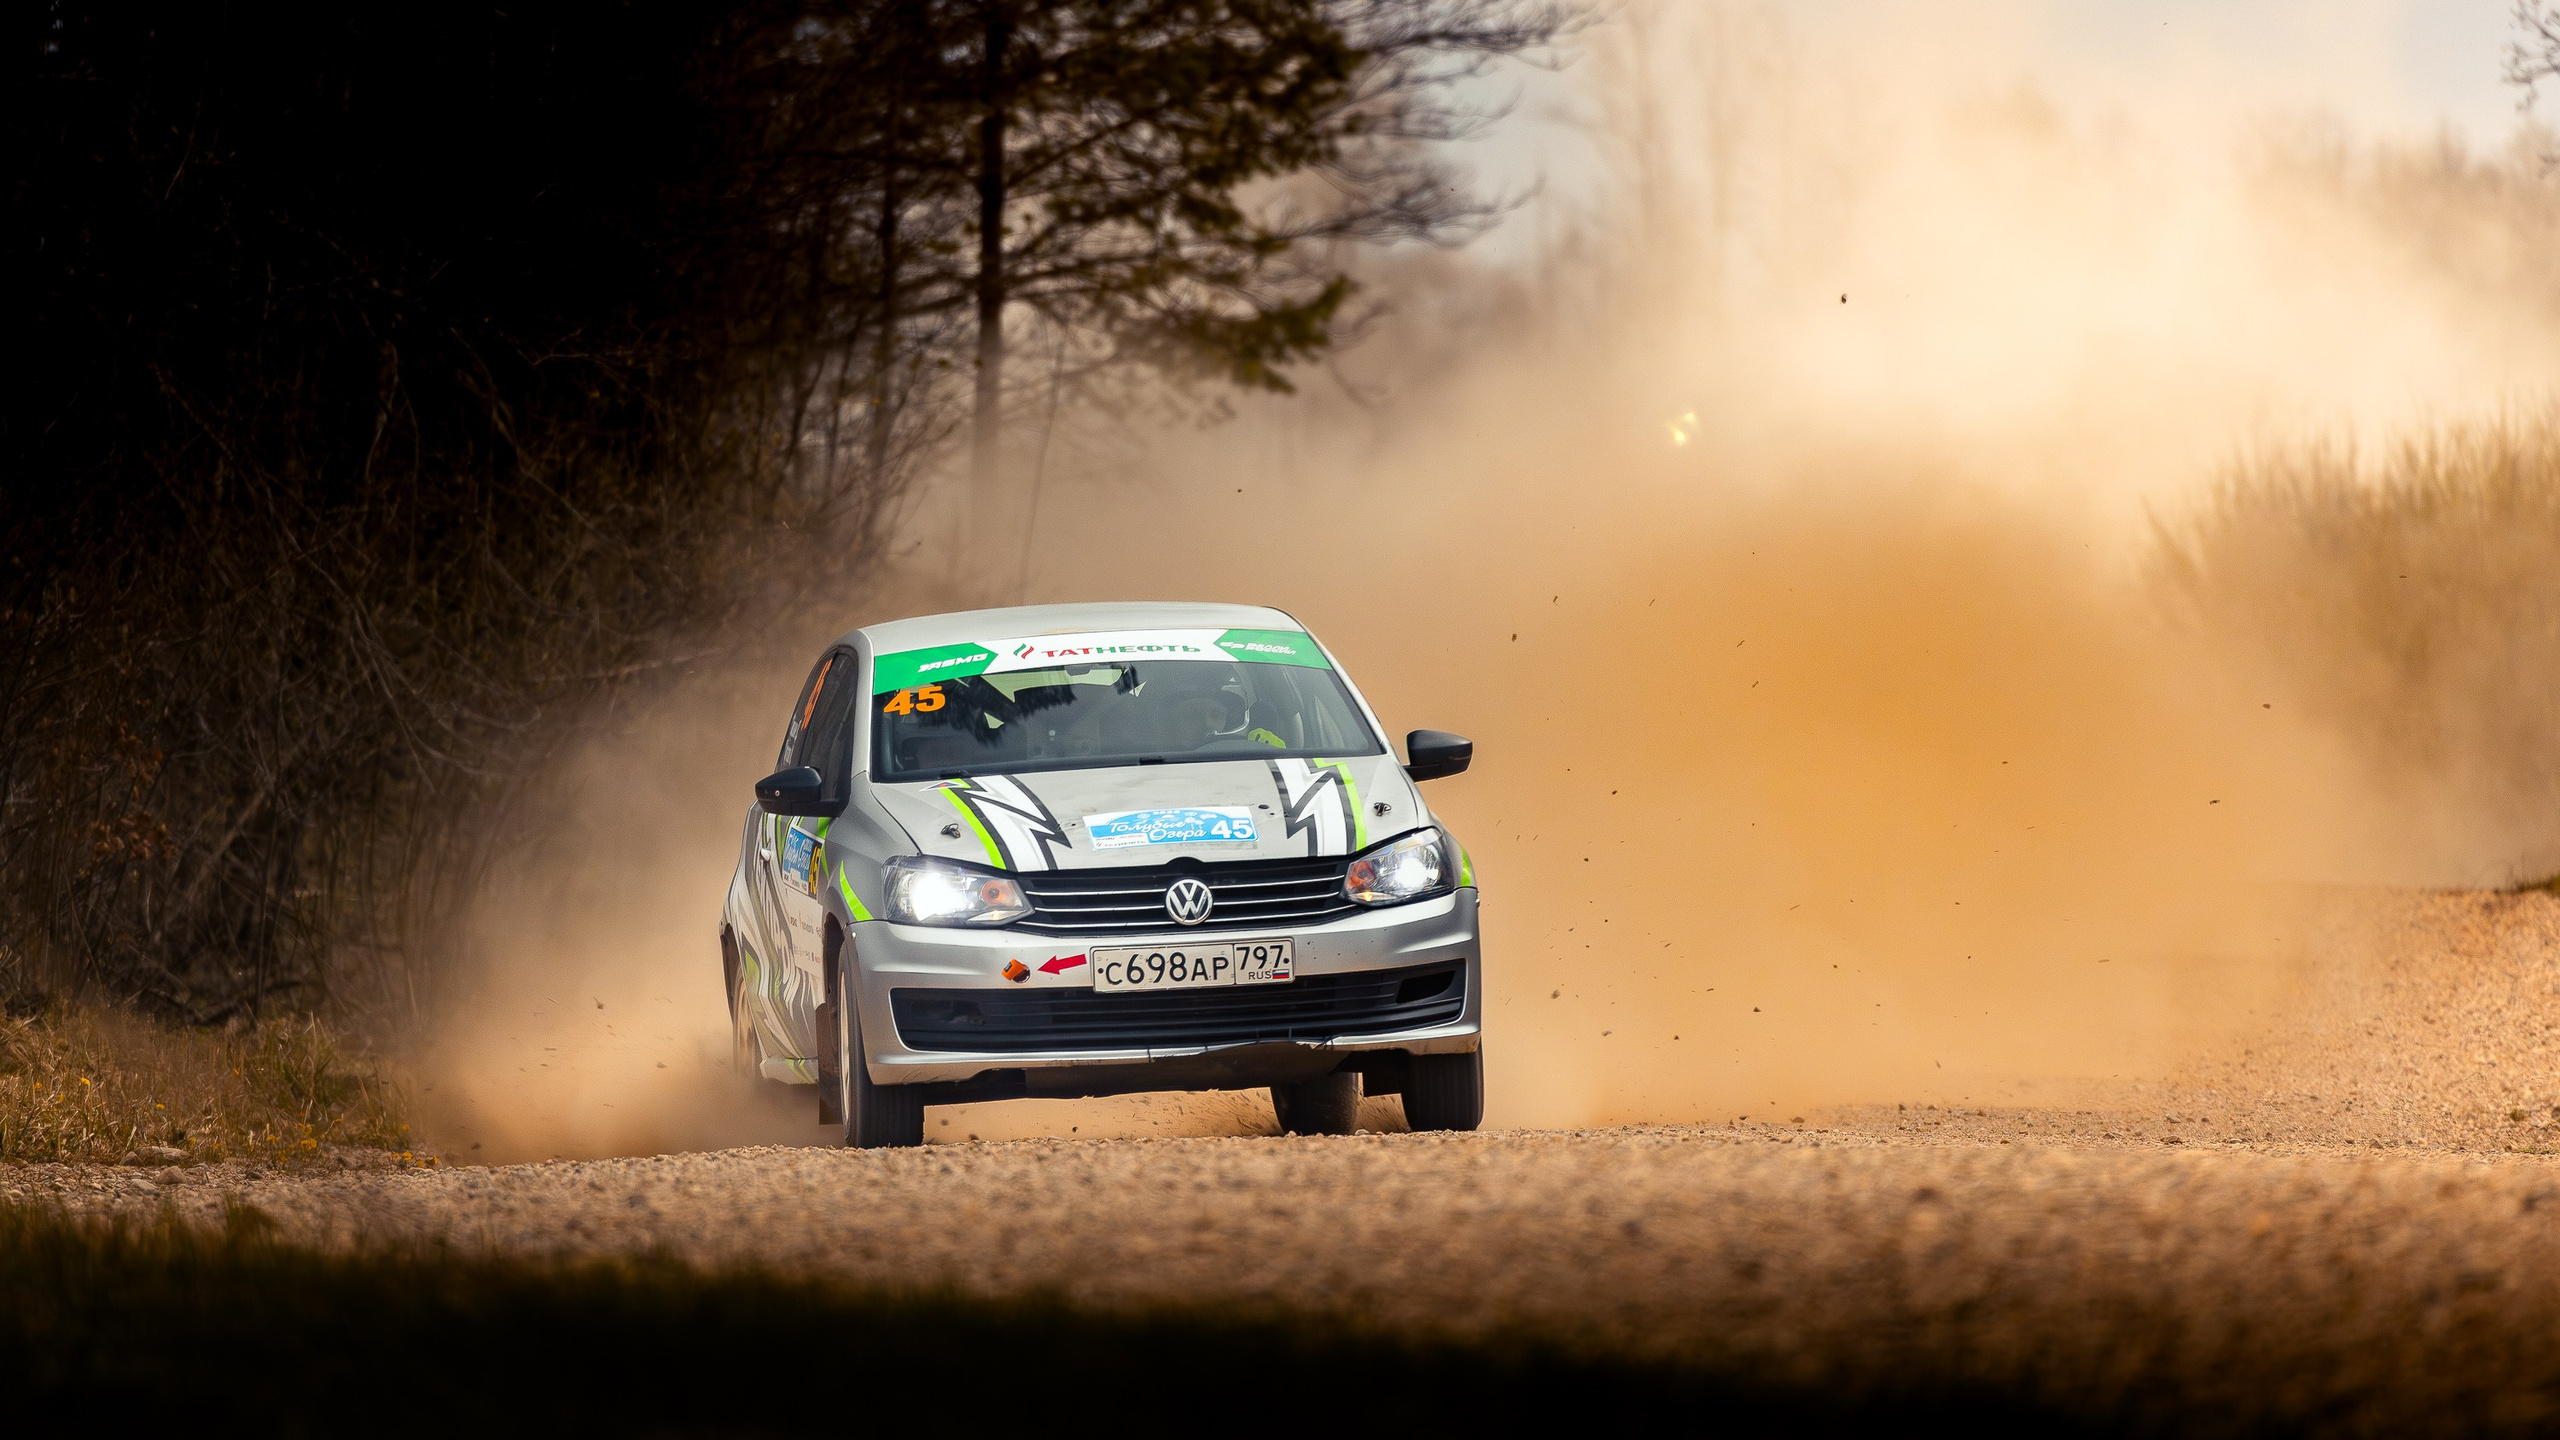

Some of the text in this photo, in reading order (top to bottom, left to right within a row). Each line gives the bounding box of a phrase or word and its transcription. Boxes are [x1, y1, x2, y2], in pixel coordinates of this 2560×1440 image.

[1041, 644, 1201, 658] ТАТНЕФТЬ
[883, 685, 946, 716] 45
[1150, 828, 1207, 841] Озера
[1210, 819, 1255, 839] 45
[1236, 944, 1284, 970] 797
[1248, 970, 1272, 980] RUS
